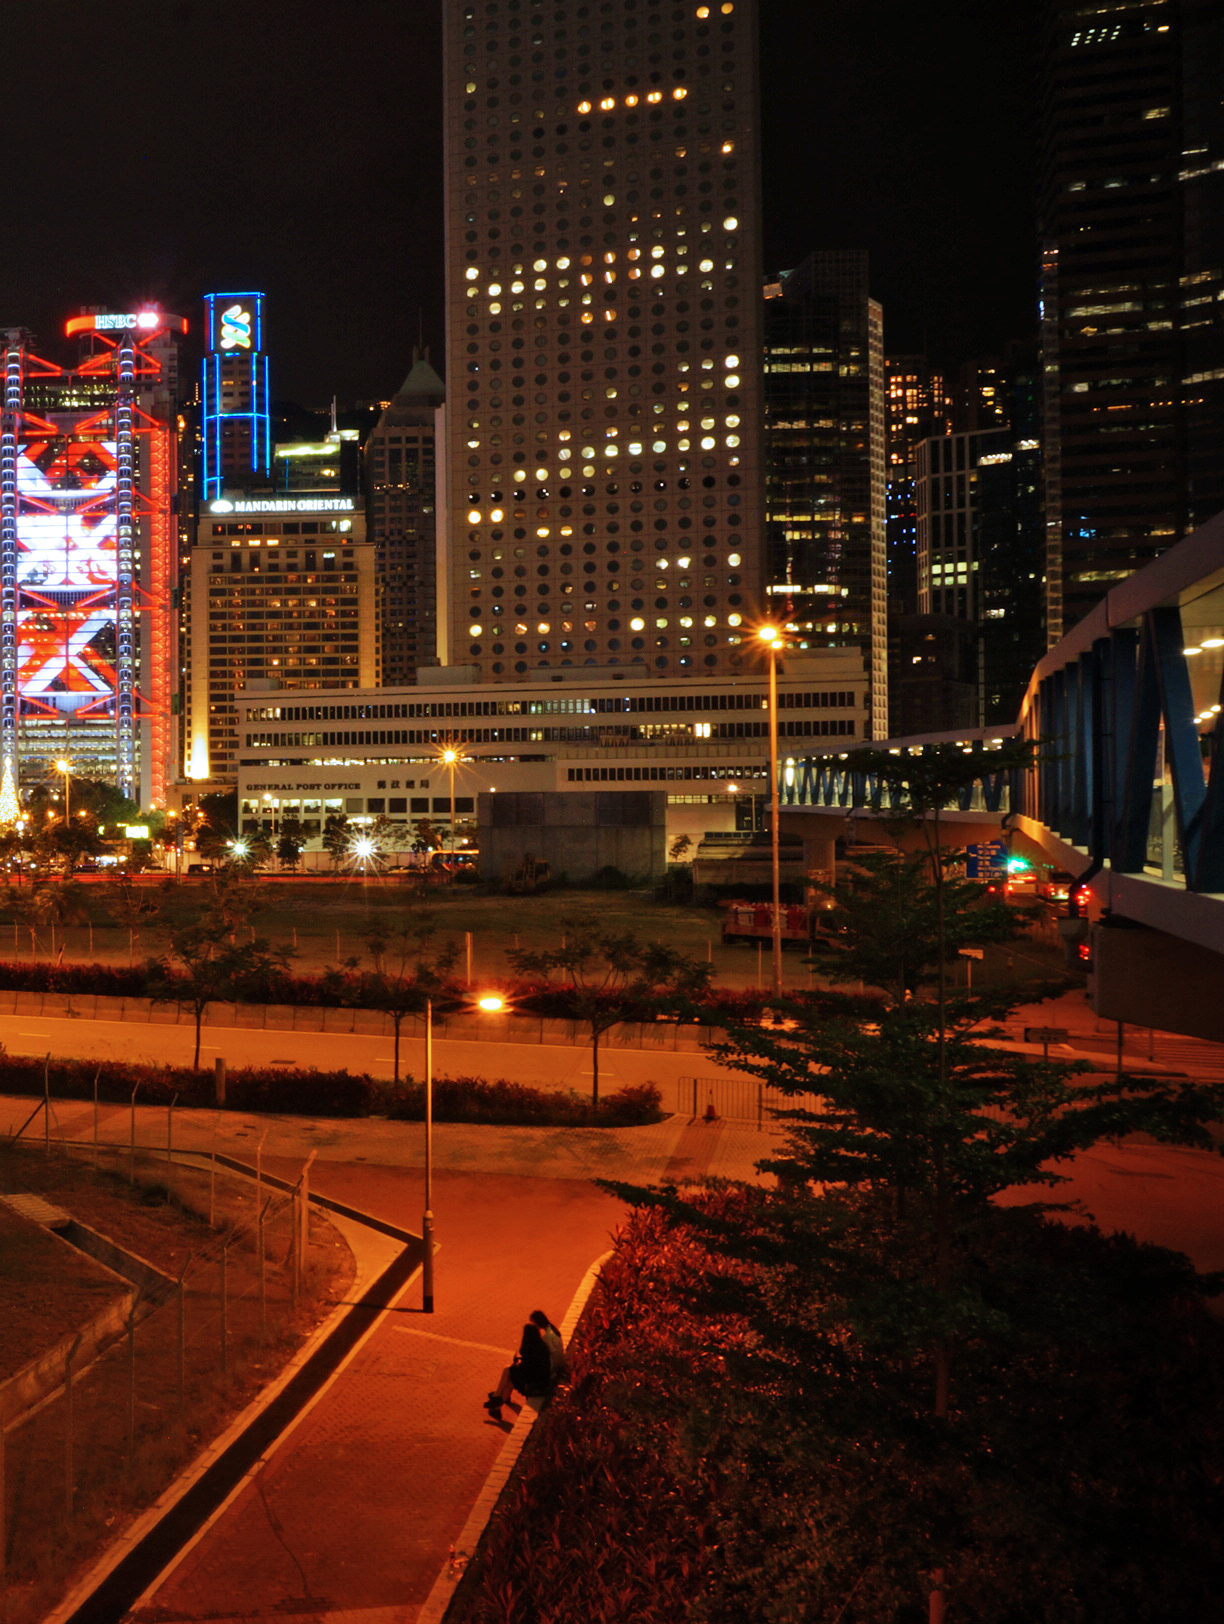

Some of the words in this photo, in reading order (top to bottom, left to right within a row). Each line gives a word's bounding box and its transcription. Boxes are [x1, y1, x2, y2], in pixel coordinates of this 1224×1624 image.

[94, 313, 136, 329] HSBC
[234, 500, 296, 512] MANDARIN
[296, 499, 354, 511] ORIENTAL
[246, 783, 294, 791] GENERAL
[324, 782, 361, 790] OFFICE
